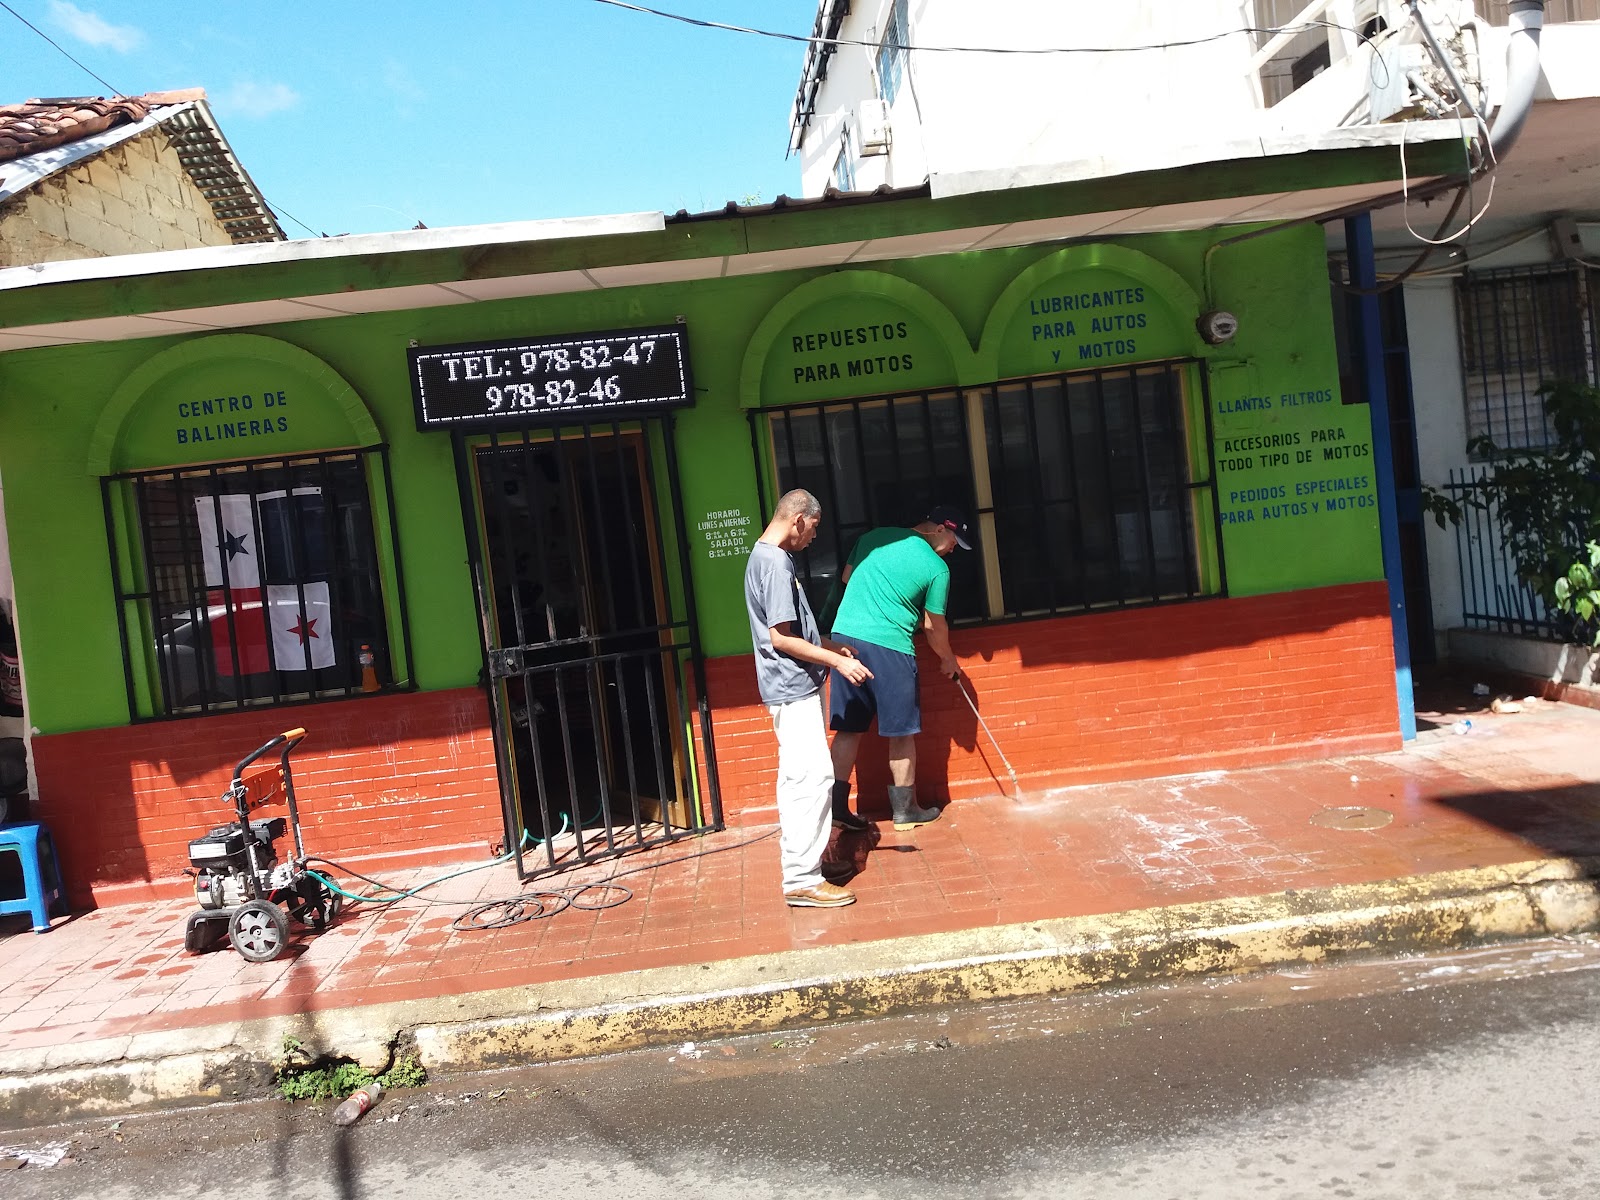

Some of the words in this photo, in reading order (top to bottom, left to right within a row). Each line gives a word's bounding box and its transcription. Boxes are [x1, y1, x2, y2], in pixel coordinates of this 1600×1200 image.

[1030, 287, 1145, 316] LUBRICANTES
[792, 322, 907, 353] REPUESTOS
[1032, 320, 1076, 341] PARA
[1091, 313, 1147, 334] AUTOS
[442, 355, 512, 382] TEL:
[520, 341, 656, 374] 978-82-47
[1078, 339, 1136, 360] MOTOS
[793, 363, 840, 383] PARA
[847, 354, 913, 377] MOTOS
[178, 395, 253, 418] CENTRO
[263, 391, 287, 408] DE
[485, 375, 621, 411] 978-82-46
[1218, 396, 1272, 414] LLANTAS
[1280, 389, 1332, 407] FILTROS
[176, 416, 288, 444] BALINERAS
[1224, 432, 1300, 453] ACCESORIOS
[1311, 427, 1346, 443] PARA
[1218, 457, 1253, 473] TODO
[1260, 452, 1289, 468] TIPO
[1296, 449, 1312, 464] DE
[1323, 443, 1369, 461] MOTOS
[1230, 485, 1286, 504] PEDIDOS
[1295, 476, 1369, 496] ESPECIALES
[697, 520, 718, 531] LUNES
[723, 516, 751, 528] VIERNES
[706, 508, 740, 520] HORARIO
[1219, 509, 1255, 525] PARA
[1263, 502, 1308, 519] AUTOS
[1326, 494, 1375, 511] MOTOS
[710, 537, 744, 549] SABADO
